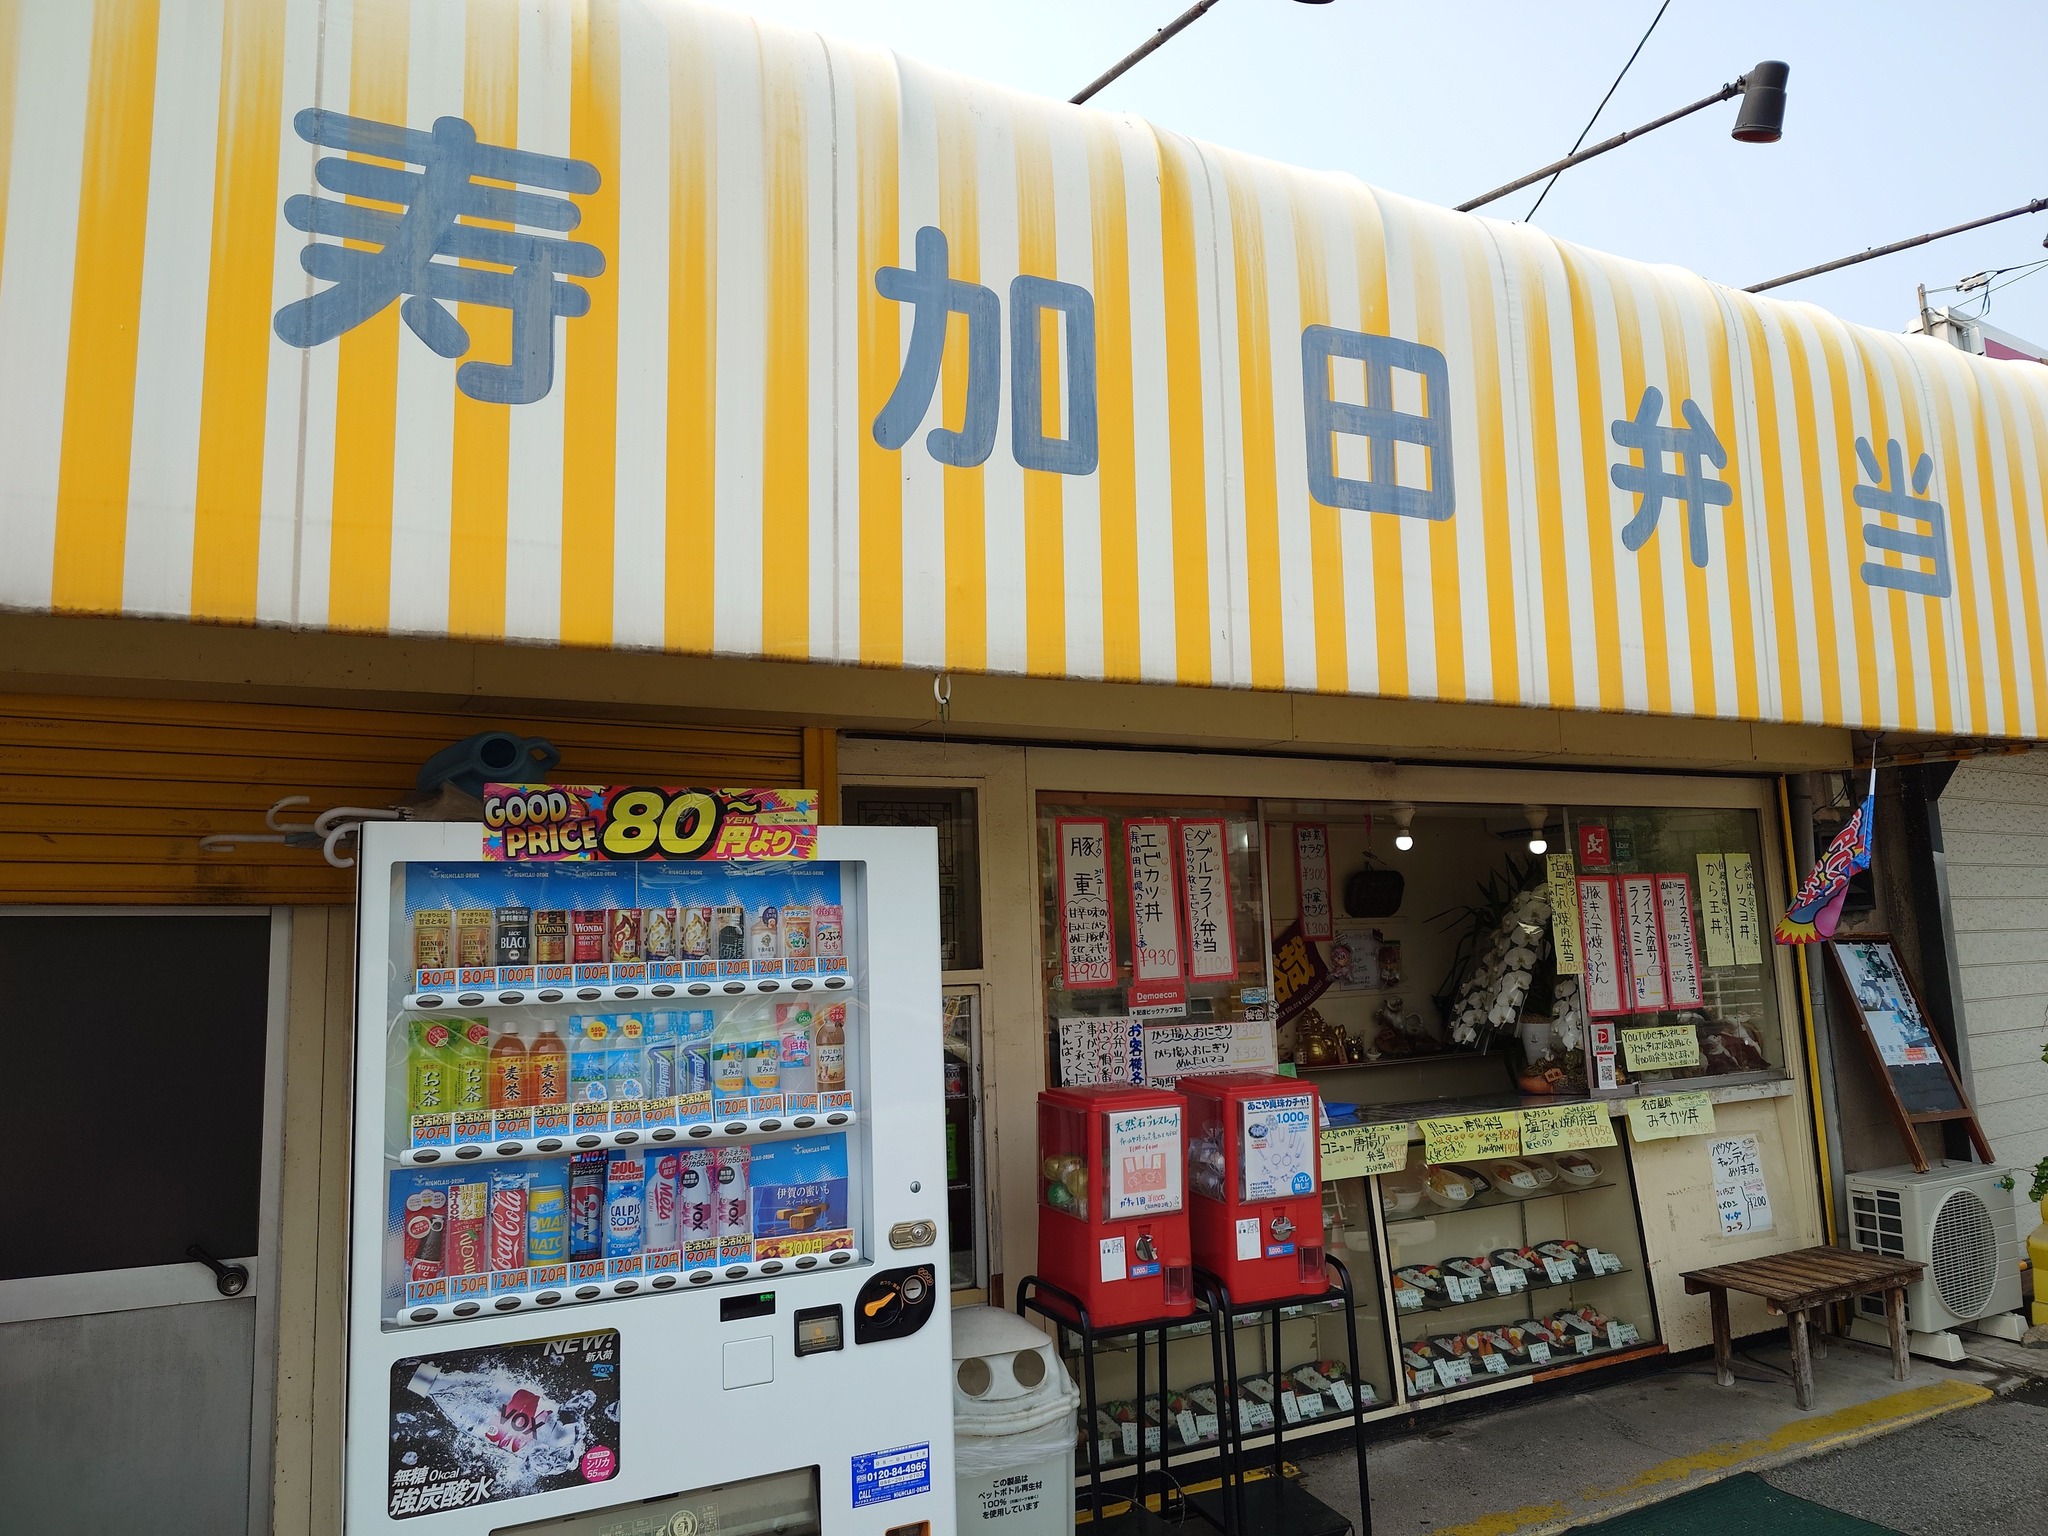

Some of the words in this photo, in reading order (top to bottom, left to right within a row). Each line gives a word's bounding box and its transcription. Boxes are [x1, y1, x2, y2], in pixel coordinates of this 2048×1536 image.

[274, 108, 1951, 598] 寿加田弁当
[485, 792, 569, 828] GOOD
[603, 790, 717, 855] 80
[725, 816, 754, 825] YEN
[503, 819, 599, 858] PRICE
[716, 825, 793, 856] 円より
[1071, 837, 1098, 896] 豚重
[1140, 833, 1163, 922] エビカツ丼
[1194, 830, 1218, 953] ダブルフライ弁当
[1734, 866, 1750, 940] とりマヨ丼
[1551, 860, 1574, 962] 塩だれ焼肉弁当
[539, 924, 566, 933] WONDA
[575, 924, 603, 933] WONDA
[1642, 885, 1658, 964] ライス大盛り
[501, 937, 527, 949] BLACK
[819, 957, 848, 970] 120円
[1140, 948, 1176, 967] ¥930
[577, 965, 609, 979] 100円
[614, 964, 646, 978] 100円
[651, 963, 682, 978] 110円
[687, 962, 717, 976] 110円
[720, 961, 750, 974] 120円
[754, 959, 783, 973] 120円
[787, 958, 816, 972] 120円
[1070, 963, 1109, 981] ¥920
[421, 971, 455, 985] 80円
[462, 969, 495, 983] 80円
[501, 968, 534, 982] 100円
[539, 966, 572, 981] 100円
[1137, 992, 1178, 1001] Demaecan
[1622, 1029, 1680, 1043] YouTubeチャンネル
[790, 1040, 807, 1050] 白桃
[1113, 1021, 1125, 1080] お弁当の
[1074, 1021, 1086, 1084] ご了承くだ
[1128, 1023, 1144, 1086] お客様各
[462, 1068, 482, 1103] お茶
[504, 1065, 521, 1100] 麦茶
[541, 1063, 557, 1098] 麦茶
[420, 1072, 441, 1107] お茶
[718, 1099, 748, 1113] 120円
[752, 1098, 782, 1112] 120円
[788, 1095, 818, 1110] 110円
[823, 1093, 852, 1107] 120円
[645, 1109, 675, 1121] 90円
[681, 1102, 710, 1115] 90円
[536, 1116, 568, 1128] 90円
[576, 1114, 607, 1126] 80円
[614, 1111, 641, 1123] 80円
[1647, 1107, 1699, 1127] みそカツ丼
[416, 1126, 449, 1139] 90円
[457, 1122, 490, 1135] 90円
[497, 1120, 530, 1133] 90円
[581, 1150, 608, 1163] NO.1
[1717, 1151, 1746, 1167] キャンディ
[611, 1161, 644, 1175] 500ml
[1728, 1162, 1760, 1178] あります。
[777, 1185, 830, 1198] 伊賀の蜜いも
[1148, 1194, 1166, 1203] ¥1000
[461, 1185, 473, 1219] 山形りん
[660, 1182, 675, 1220] Mets
[1748, 1195, 1767, 1209] ¥200
[611, 1204, 641, 1216] CALPIS
[692, 1202, 703, 1231] VOX
[728, 1198, 739, 1227] VOX
[537, 1215, 563, 1230] MAT
[611, 1217, 640, 1226] SODA
[1726, 1222, 1743, 1232] コーラ
[530, 1236, 563, 1249] MATC
[785, 1239, 823, 1254] 300円
[687, 1250, 716, 1262] 90円
[722, 1246, 751, 1259] 90円
[609, 1258, 641, 1273] 120円
[646, 1254, 679, 1269] 120円
[533, 1267, 567, 1282] 120円
[572, 1262, 604, 1278] 120円
[453, 1277, 488, 1293] 150円
[493, 1272, 528, 1288] 130円
[410, 1283, 446, 1300] 120円
[544, 1335, 615, 1356] NEW!
[585, 1350, 613, 1362] 新入荷
[594, 1365, 612, 1375] VOX
[500, 1405, 546, 1439] VOX
[587, 1458, 610, 1469] シリカ
[393, 1466, 429, 1487] 無糖
[429, 1467, 459, 1481] 0kcal
[993, 1475, 1028, 1488] この製品は
[390, 1476, 495, 1516] 強炭酸水
[859, 1490, 871, 1500] CALL
[978, 1481, 1042, 1499] ペットボトル再生材
[982, 1498, 1007, 1509] 100%
[982, 1501, 1040, 1519] を使用しています
